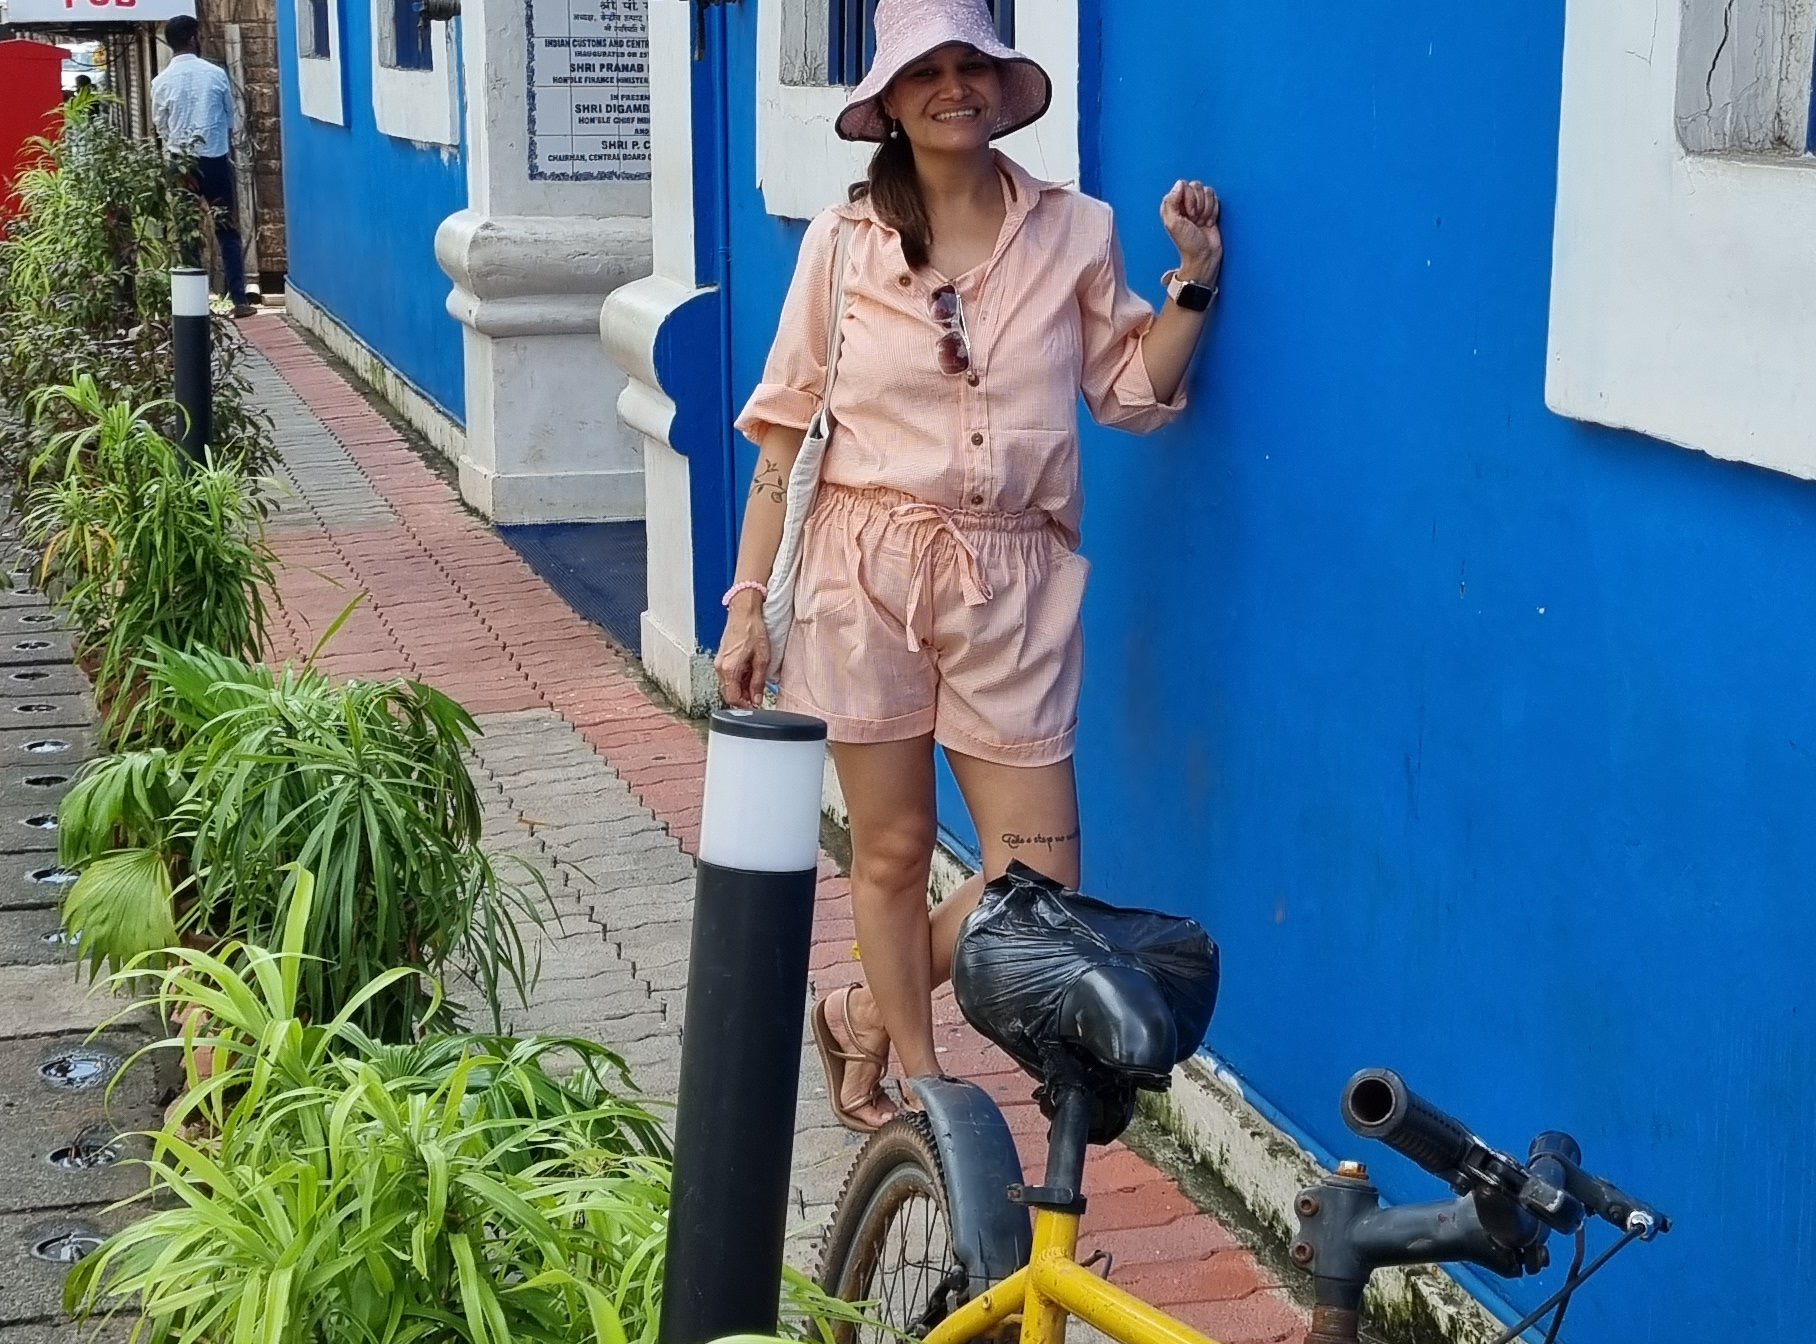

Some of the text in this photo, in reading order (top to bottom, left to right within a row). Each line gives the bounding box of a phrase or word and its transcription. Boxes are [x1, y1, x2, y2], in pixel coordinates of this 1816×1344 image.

[544, 38, 570, 48] INDIAN
[571, 38, 607, 48] CUSTOMS
[608, 39, 625, 48] AND
[574, 50, 626, 58] INAUGURATED
[570, 63, 596, 73] SHRI
[599, 63, 644, 73] PRANAB
[584, 76, 615, 84] FINANCE
[574, 103, 603, 114] SHRI
[578, 116, 611, 125] HON'BLE
[613, 116, 636, 125] CHIEF
[601, 140, 628, 150] SHRI
[631, 140, 641, 150] P.
[547, 153, 588, 162] CHAIRMAN,
[588, 153, 621, 162] CENTRAL
[622, 153, 647, 161] BOARD
